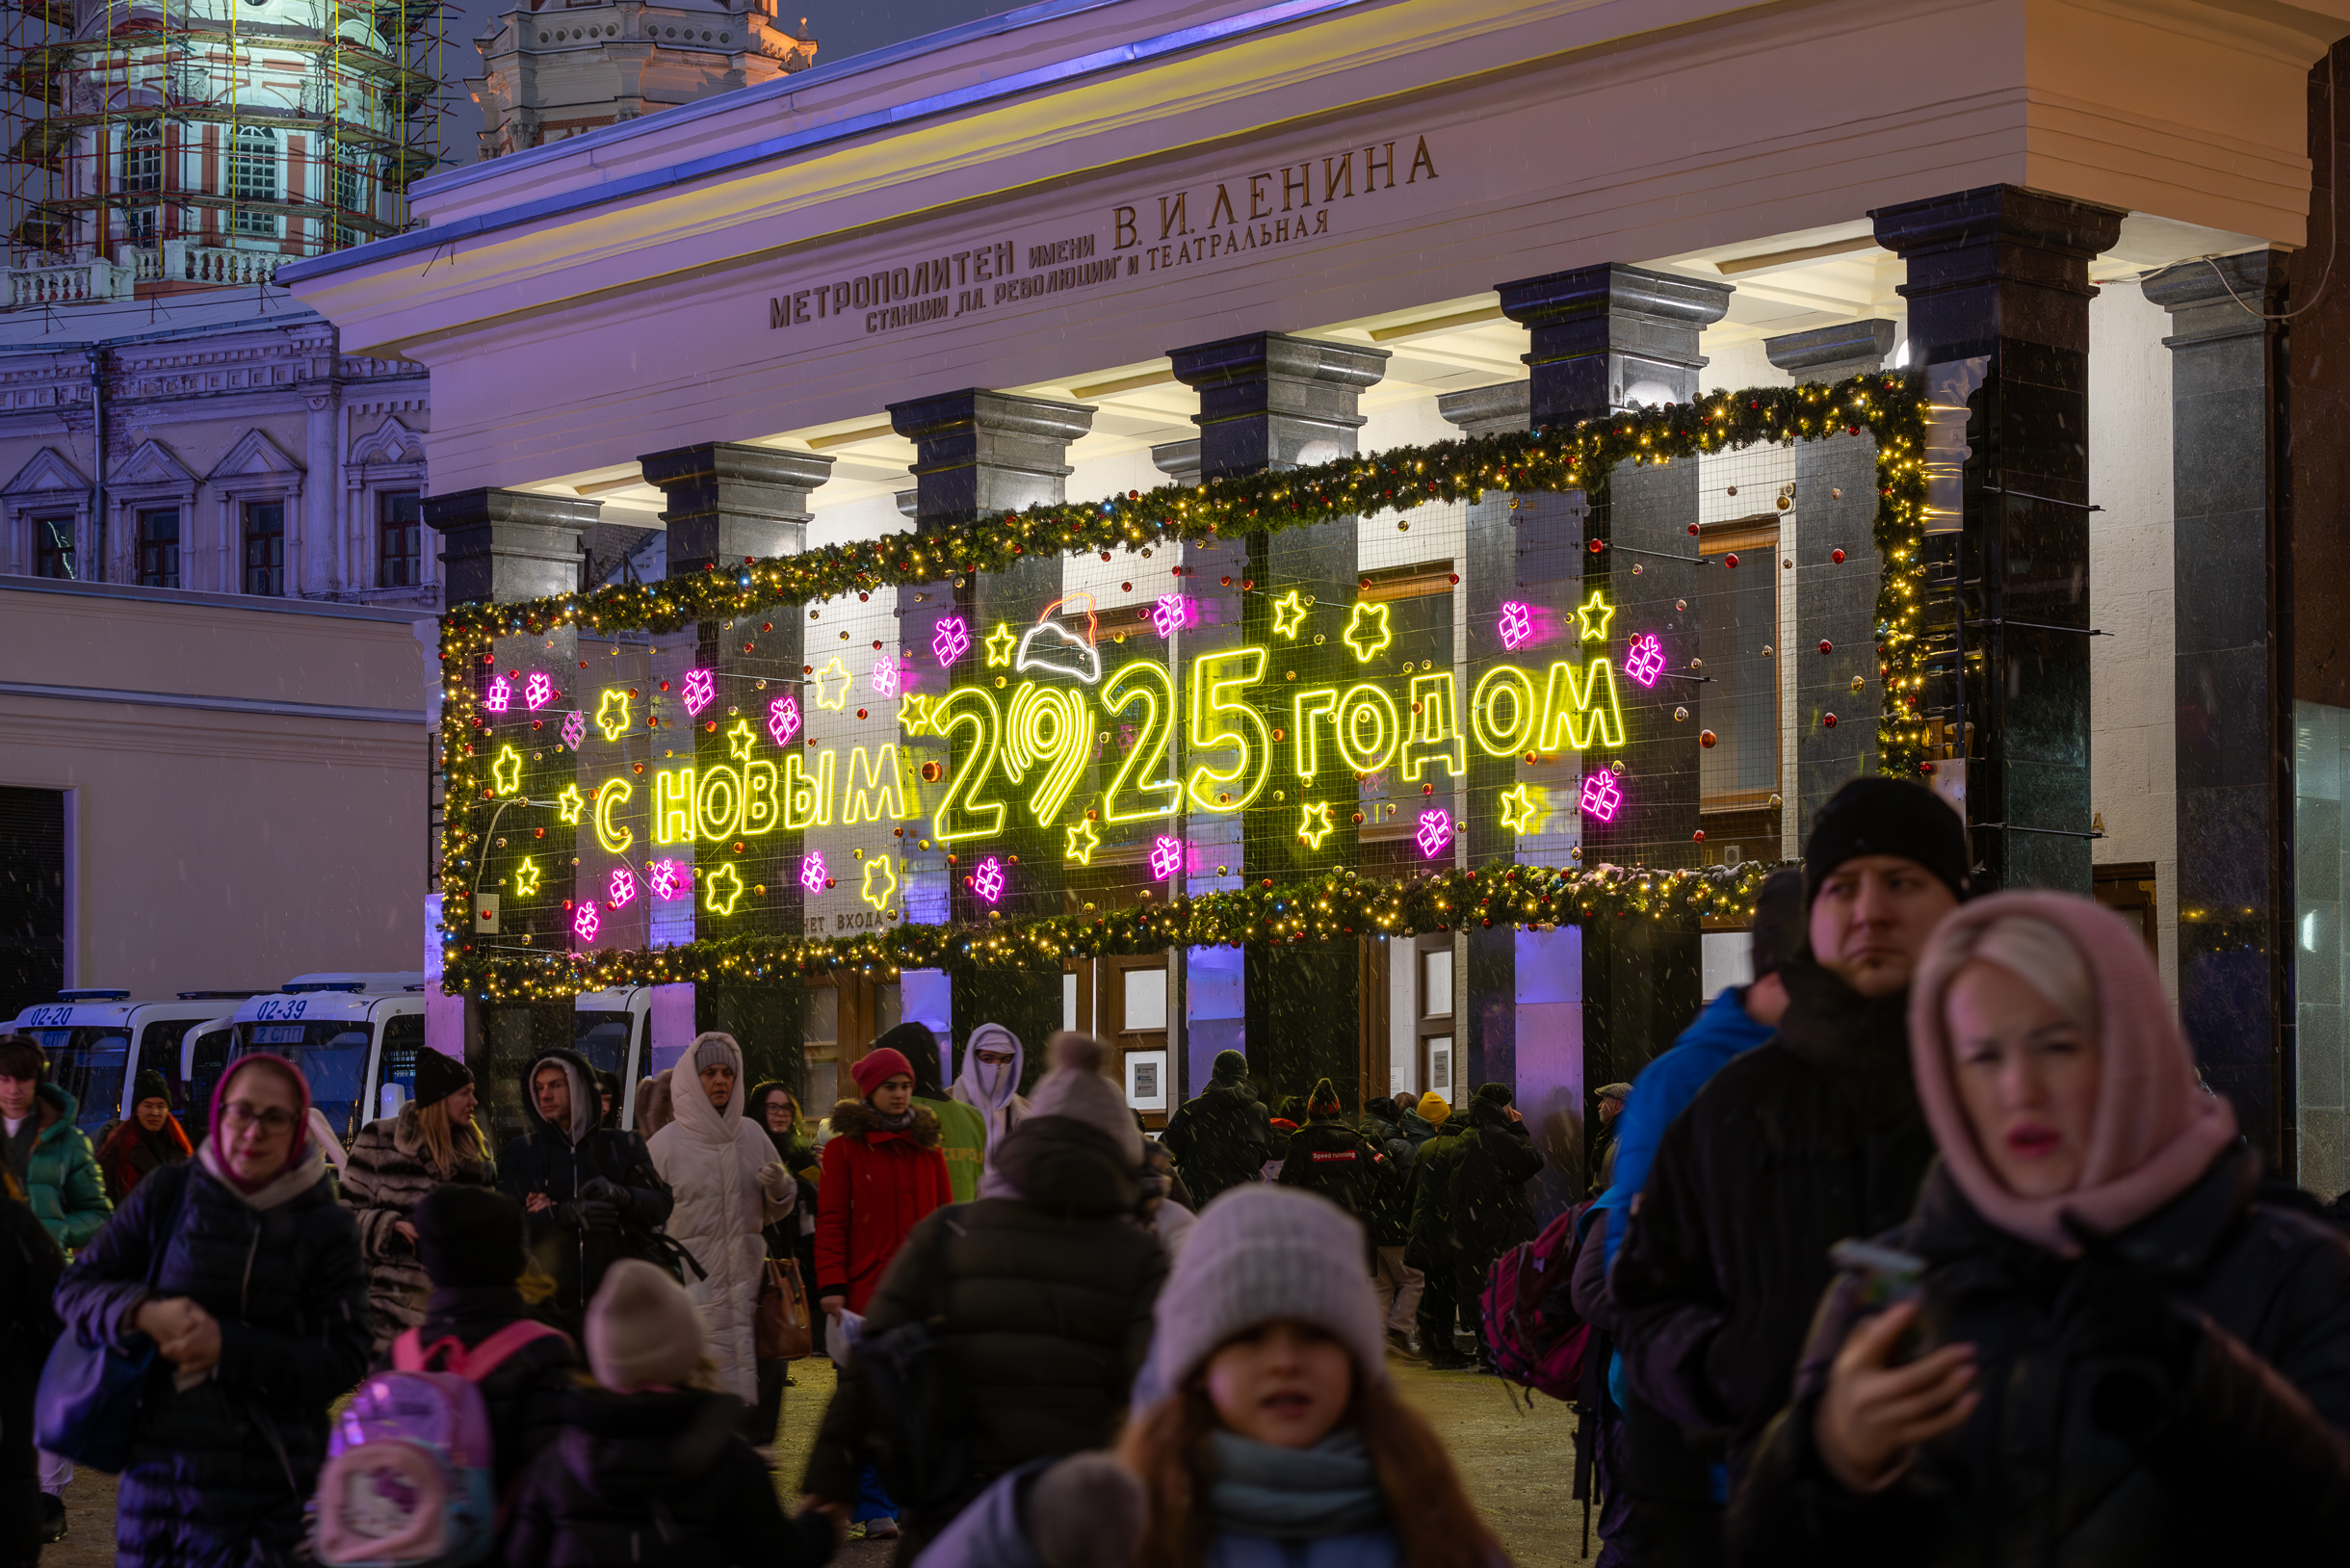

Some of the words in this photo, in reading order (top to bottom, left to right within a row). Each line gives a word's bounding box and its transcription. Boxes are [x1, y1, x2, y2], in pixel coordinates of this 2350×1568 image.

[770, 240, 1014, 329] МЕТРОПОЛИТЕН
[1029, 234, 1095, 270] ИМЕНИ
[1112, 205, 1143, 250] В.
[1157, 191, 1196, 241] И.
[1207, 134, 1440, 229] ЛЕНИНА
[866, 295, 949, 333] СТАНЦИИ
[1127, 254, 1139, 276] И
[1146, 208, 1329, 272] ТЕАТРАЛЬНАЯ
[595, 777, 633, 854] С
[657, 742, 906, 845] НОВЫМ
[1294, 657, 1626, 782] ГОДОМ
[837, 911, 884, 929] ВХОДА
[30, 1006, 74, 1027] 02-20
[256, 1000, 308, 1021] 02-39
[271, 1027, 303, 1042] СПП
